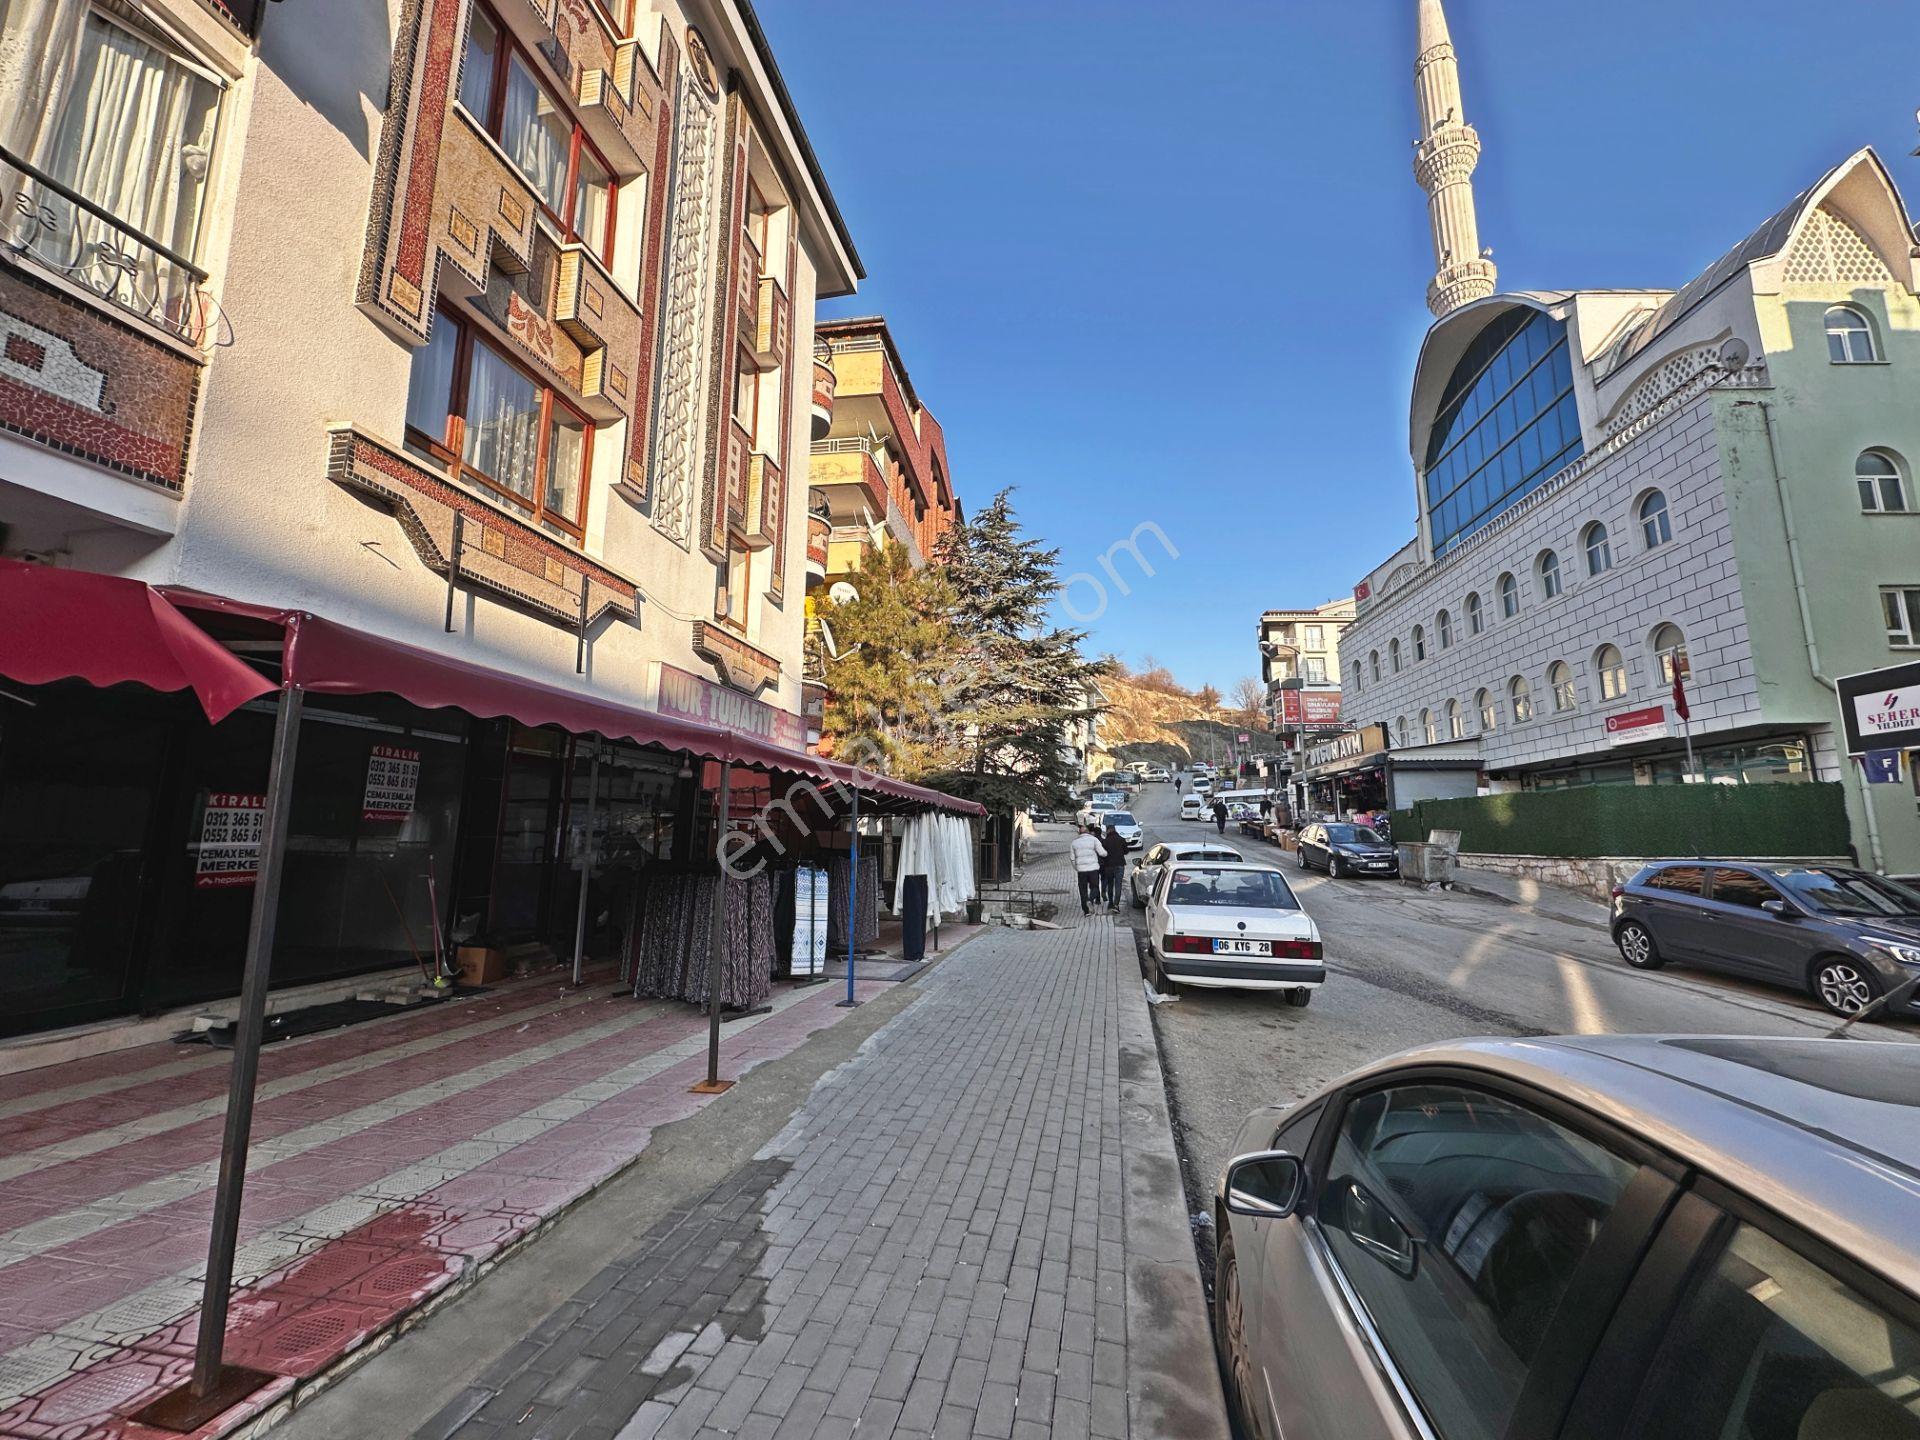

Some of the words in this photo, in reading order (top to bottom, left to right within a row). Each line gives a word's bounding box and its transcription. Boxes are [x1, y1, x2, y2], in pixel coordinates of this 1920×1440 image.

[663, 674, 703, 717] NUR
[1867, 707, 1920, 725] SEHER
[366, 801, 412, 810] MERKEZ
[205, 812, 228, 826] 0312
[232, 813, 250, 826] 365
[203, 828, 228, 842] 0552
[231, 829, 249, 842] 865
[200, 860, 260, 871] MERKE
[1218, 942, 1230, 951] 06
[1234, 942, 1251, 952] KYG
[1258, 943, 1270, 952] 28
